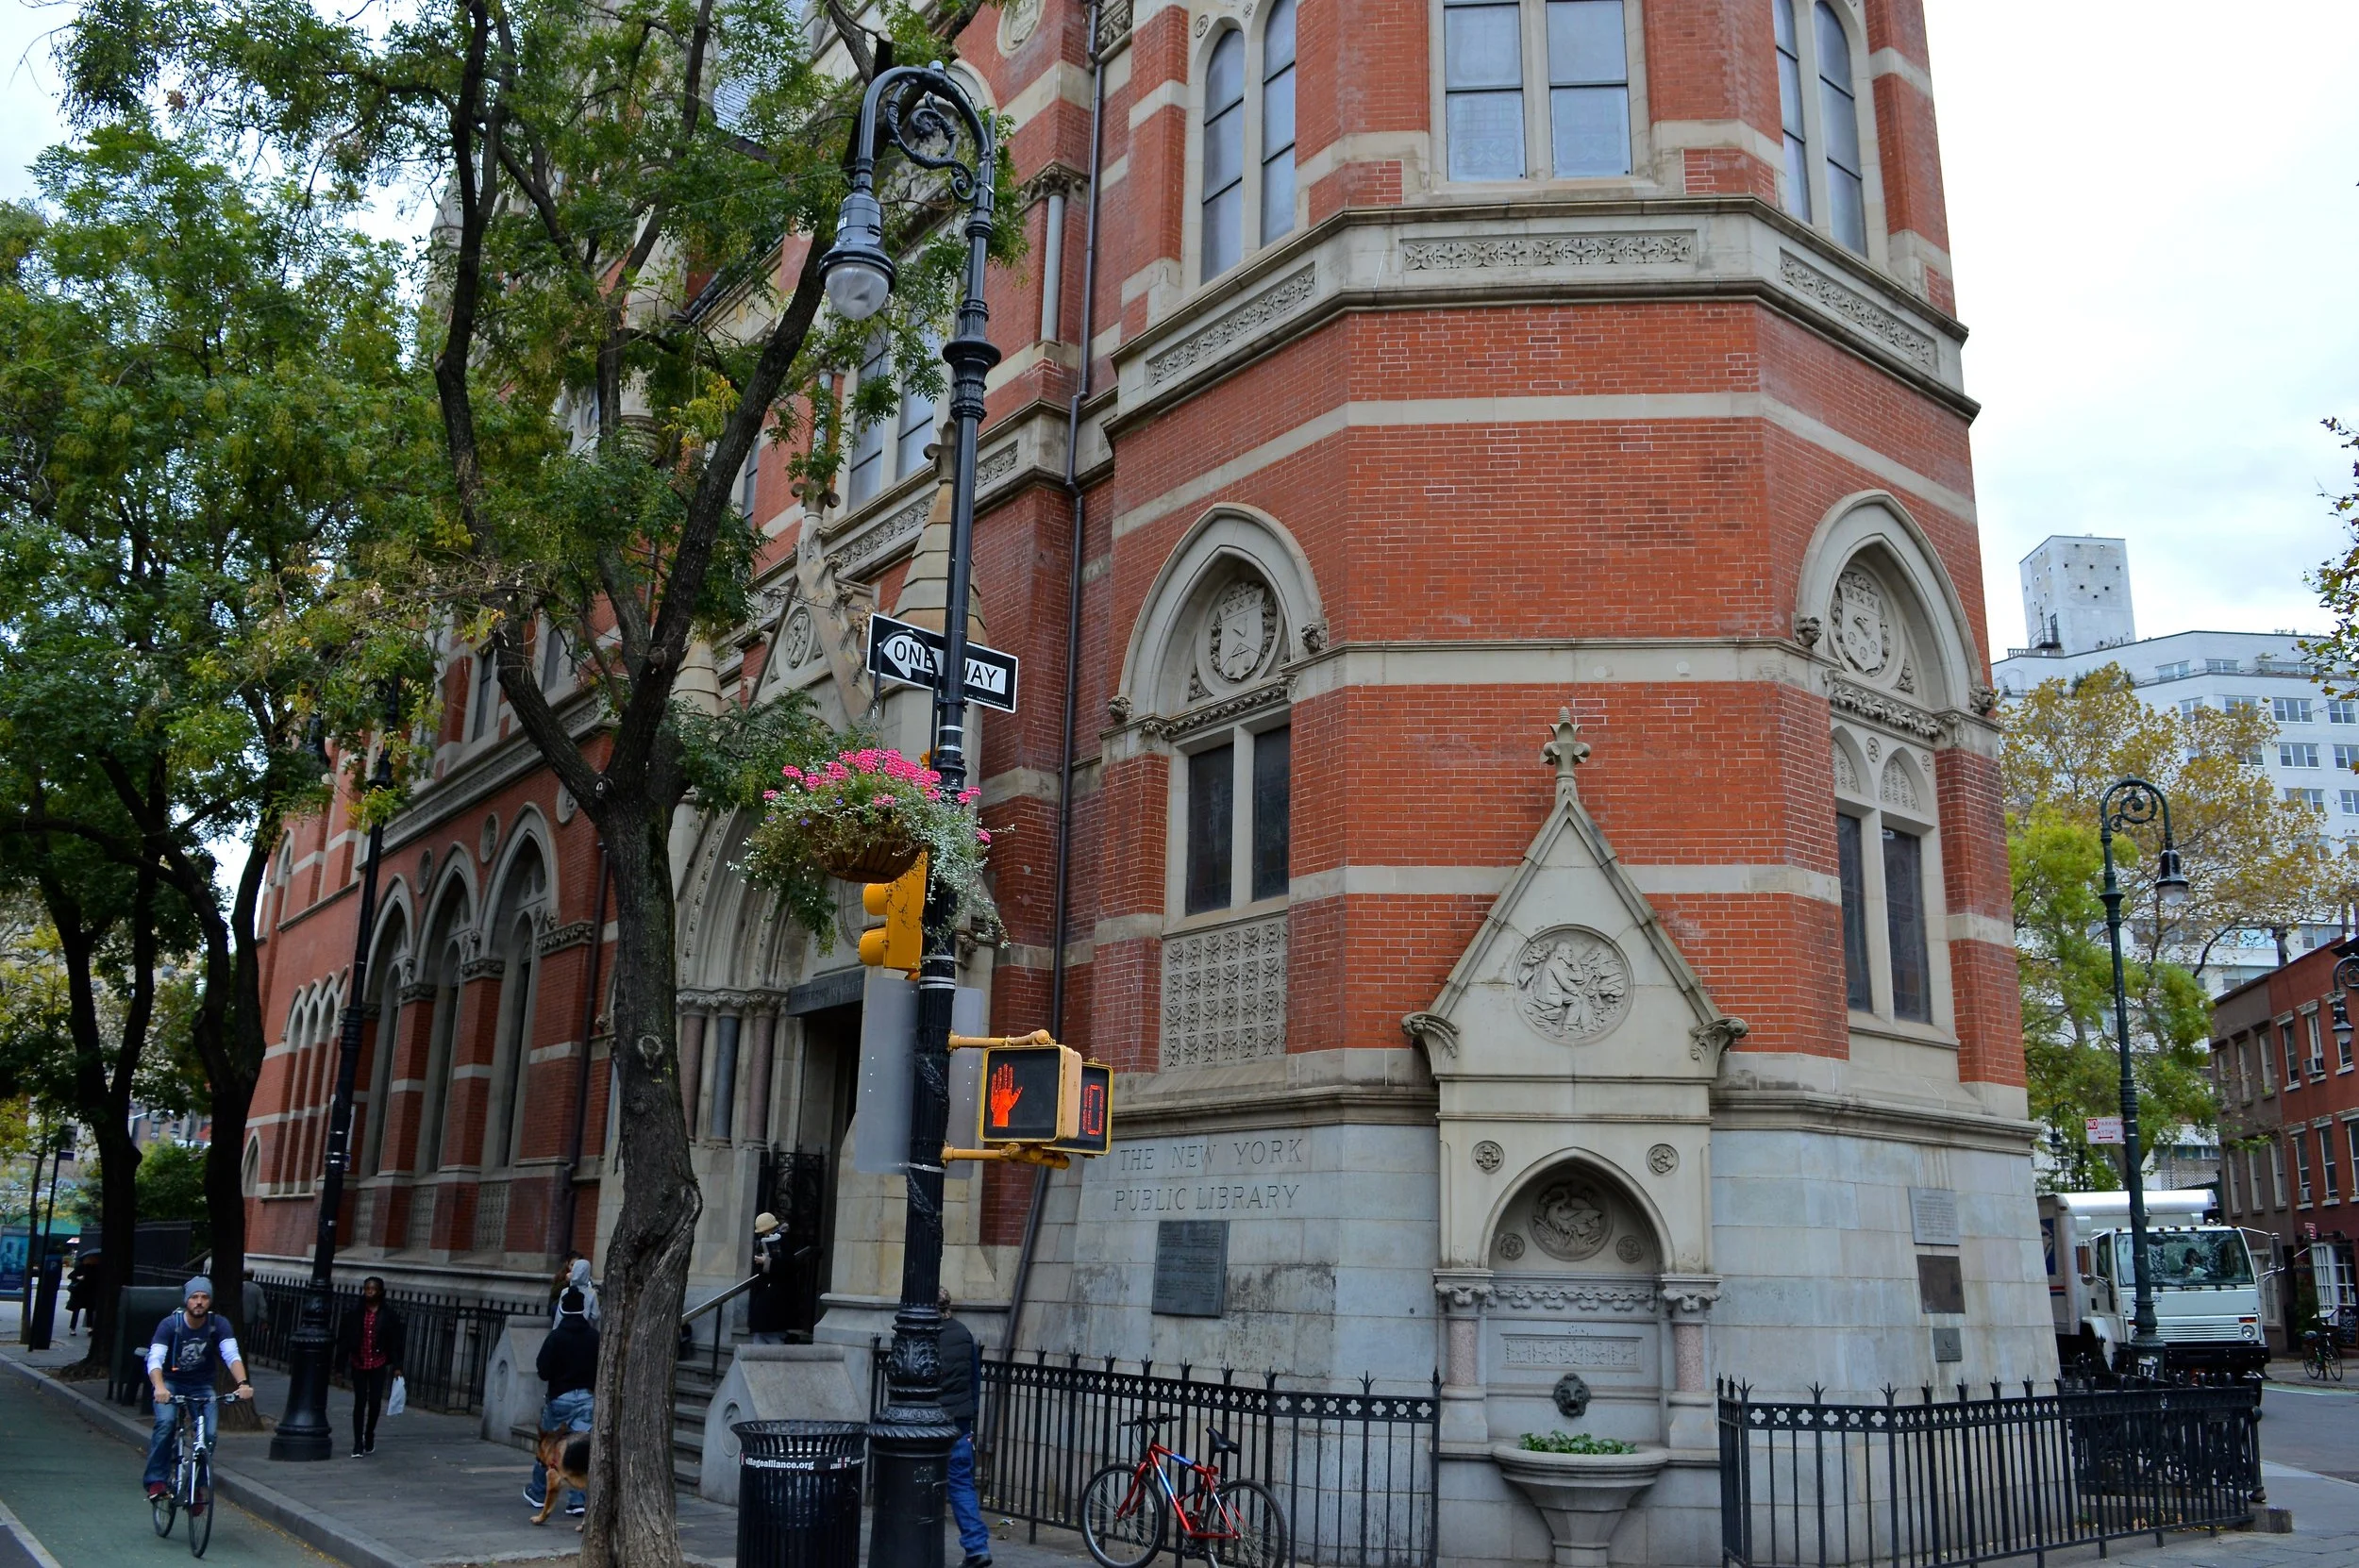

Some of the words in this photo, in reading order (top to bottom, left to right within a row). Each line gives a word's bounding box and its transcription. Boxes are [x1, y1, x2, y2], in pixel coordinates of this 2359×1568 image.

[894, 641, 934, 672] ONE
[2086, 1119, 2098, 1129] NO
[1120, 1148, 1154, 1171] THE
[1171, 1144, 1216, 1169] NEW
[1233, 1139, 1303, 1165] YORK
[1113, 1188, 1186, 1211] PUBLIC
[1196, 1184, 1299, 1210] LIBRARY
[745, 1457, 814, 1471] villagealliance.org
